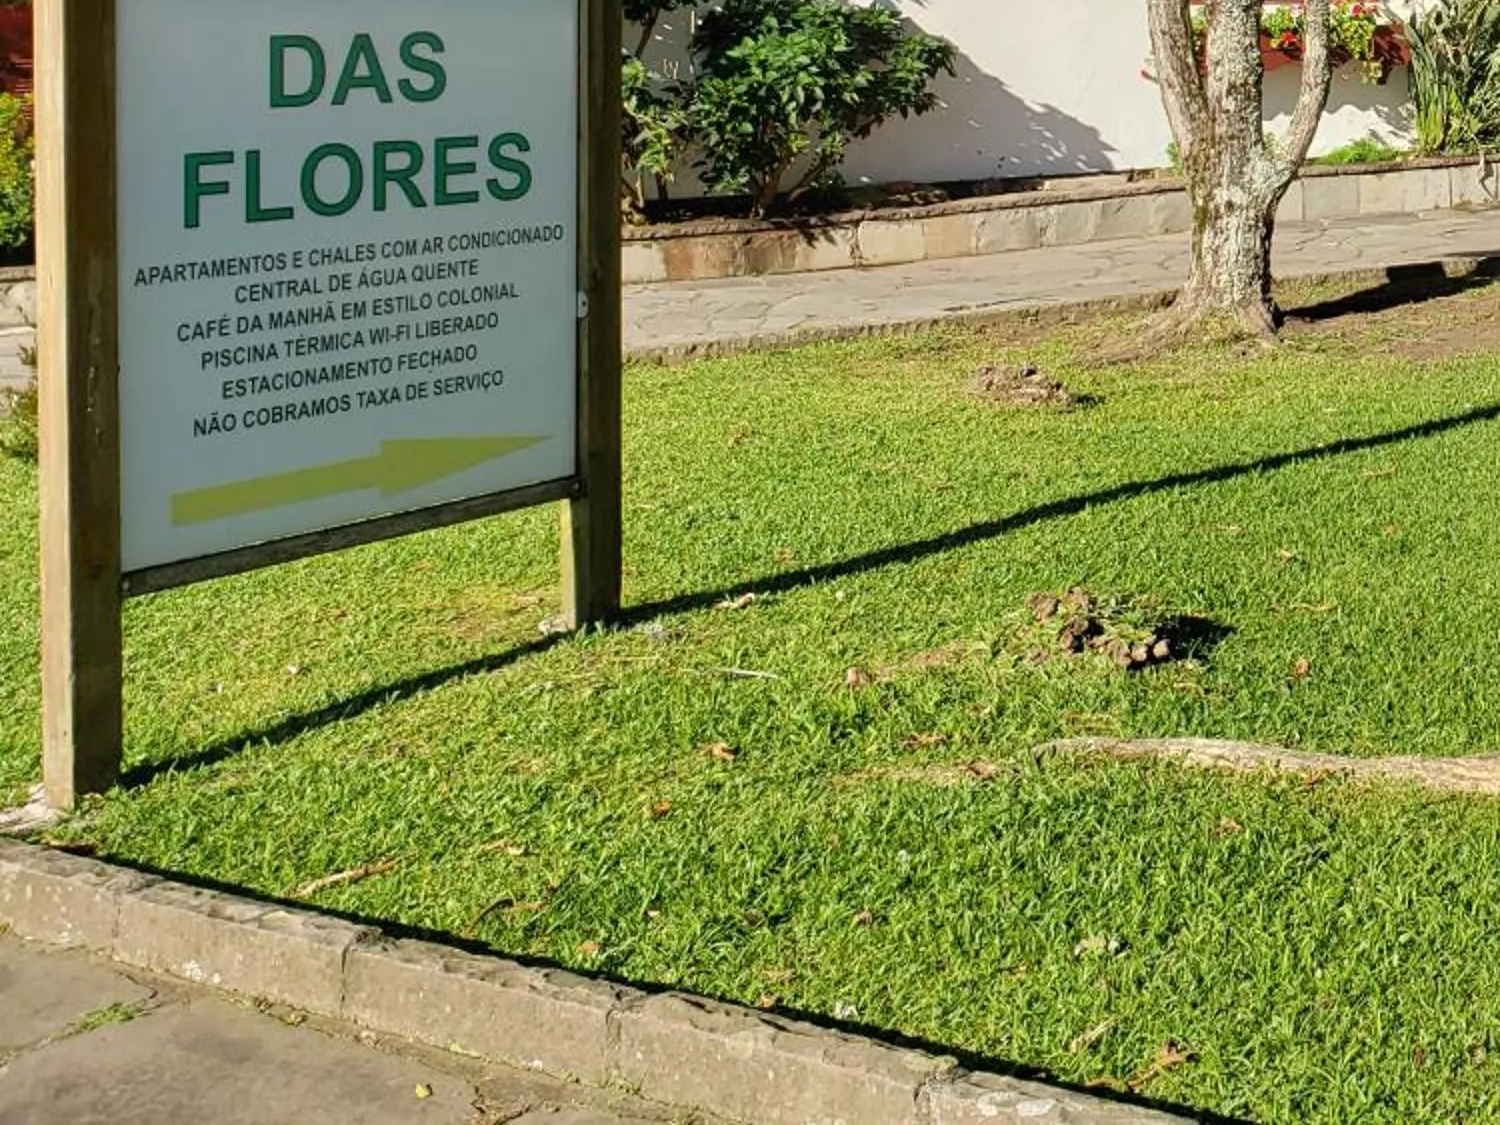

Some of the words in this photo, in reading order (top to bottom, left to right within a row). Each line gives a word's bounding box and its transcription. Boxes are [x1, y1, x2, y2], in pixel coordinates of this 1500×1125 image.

[269, 31, 447, 108] DAS
[183, 132, 532, 229] FLORES
[134, 252, 287, 287] APARTAMENTOS
[292, 250, 303, 268] E
[308, 243, 376, 267] CHALES
[381, 239, 417, 259] COM
[422, 236, 444, 255] AR
[447, 224, 564, 252] CONDICIONADO
[235, 279, 322, 303] CENTRAL
[329, 273, 352, 292] DE
[358, 266, 407, 289] ÁGUA
[411, 259, 479, 282] QUENTE
[177, 313, 230, 342] CAFÉ
[236, 315, 263, 334] DA
[269, 300, 336, 329] MANHÃ
[341, 300, 367, 320] EM
[372, 293, 432, 316] ESTILO
[437, 282, 520, 308] COLONIAL
[201, 342, 279, 371] PISCINA
[369, 324, 410, 346] WI-FI
[415, 312, 499, 339] LIBERADO
[222, 356, 393, 399] ESTACIONAMENTO
[397, 344, 477, 371] FECHADO
[193, 411, 237, 437] NÃO
[242, 394, 351, 428] COBRAMOS
[356, 387, 401, 409] TAXA
[405, 382, 428, 401] DE
[433, 370, 504, 397] SERVIÇO
